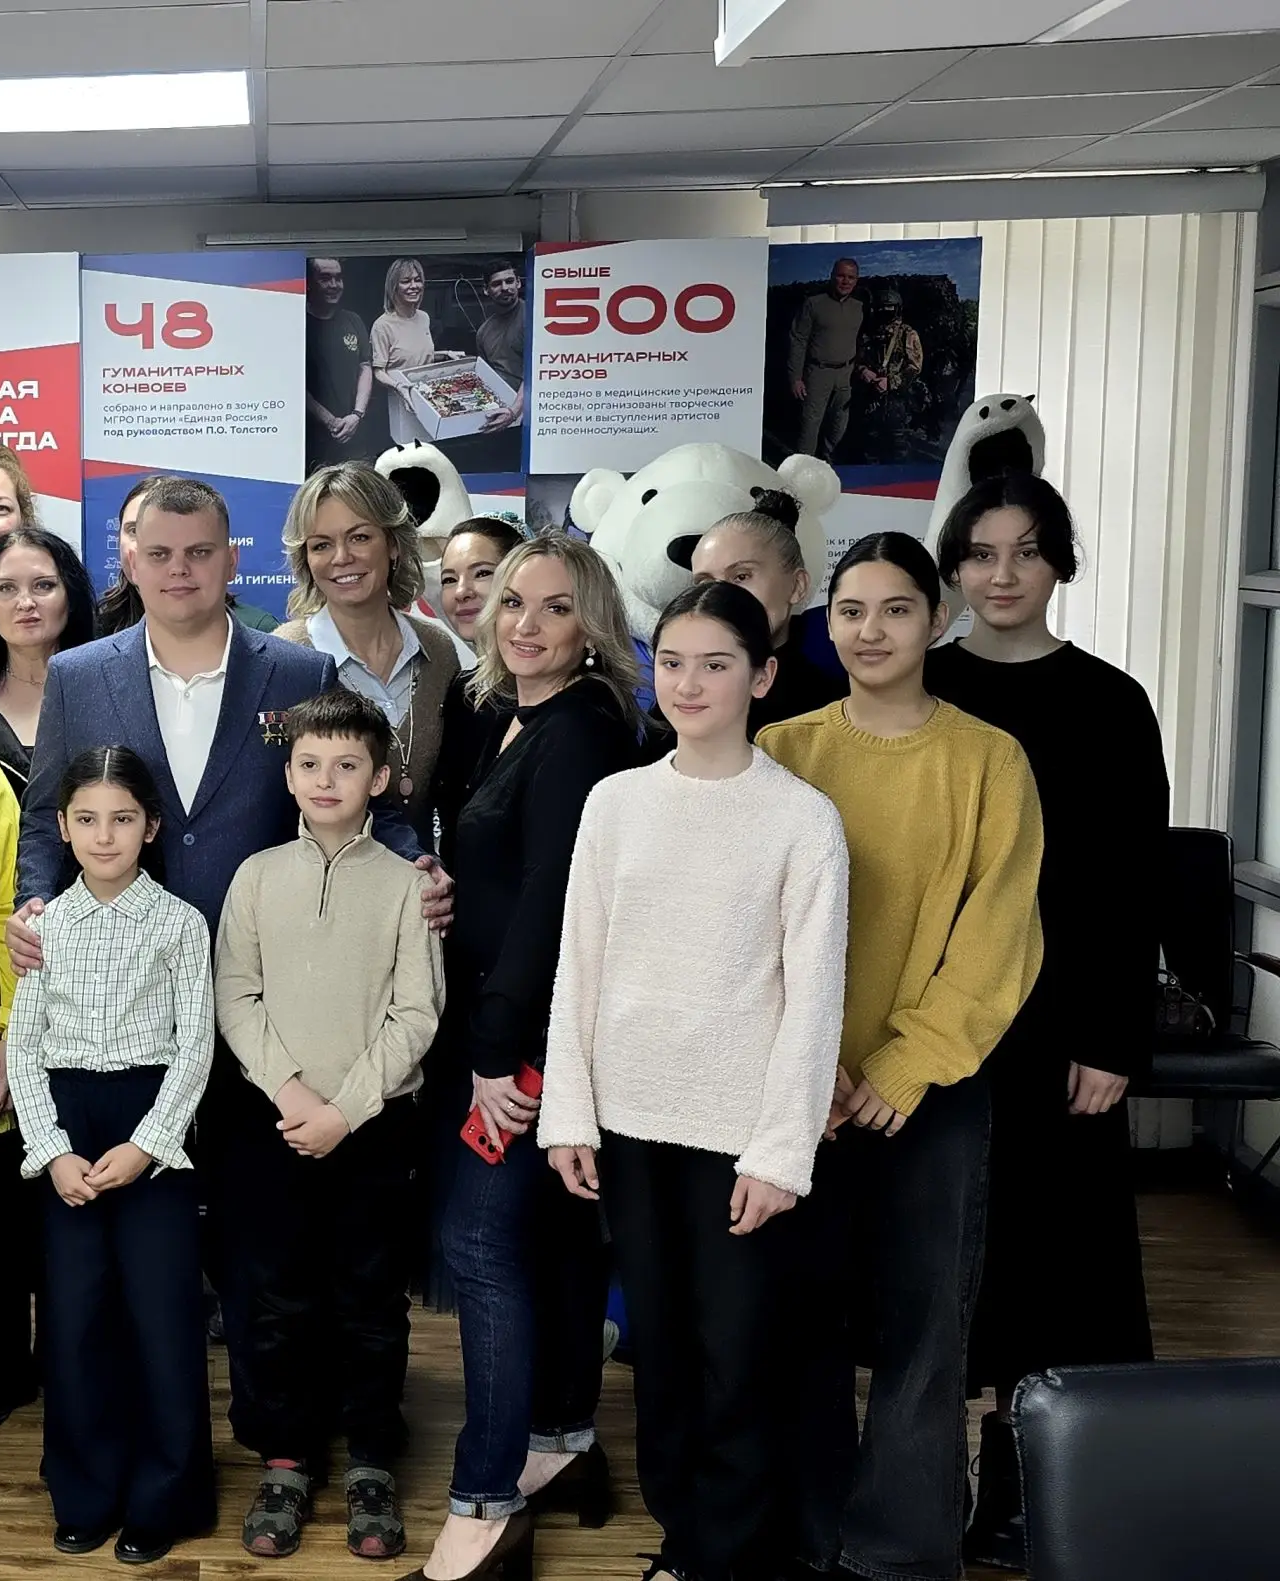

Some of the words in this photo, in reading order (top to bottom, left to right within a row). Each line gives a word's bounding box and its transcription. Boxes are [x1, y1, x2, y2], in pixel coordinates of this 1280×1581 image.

[541, 266, 611, 279] СВЫШЕ
[544, 283, 736, 336] 500
[105, 301, 214, 350] 48
[539, 350, 689, 365] ГУМАНИТАРНЫХ
[102, 364, 245, 379] ГУМАНИТАРНЫХ
[539, 368, 608, 381] ГРУЗОВ
[102, 382, 187, 394] КОНВОЕВ
[538, 390, 593, 400] передано
[595, 390, 602, 398] в
[604, 388, 681, 399] медицинские
[682, 387, 753, 398] учреждения
[102, 403, 148, 414] собрано
[149, 404, 157, 412] и
[159, 403, 224, 413] направлено
[226, 402, 233, 410] в
[235, 402, 260, 412] зону
[261, 400, 286, 410] СВО
[537, 402, 585, 411] Москвы,
[586, 401, 667, 412] организованы
[669, 400, 734, 410] творческие
[103, 415, 135, 425] МГРО
[136, 415, 176, 426] Партии
[178, 414, 223, 424] «Единая
[225, 412, 268, 422] Россия»
[536, 415, 583, 425] встречи
[595, 413, 668, 424] выступления
[670, 412, 721, 423] артистов
[103, 429, 124, 438] под
[126, 427, 203, 438] руководством
[206, 425, 228, 435] П.О.
[229, 425, 279, 435] Толстого
[537, 428, 558, 437] для
[560, 426, 659, 436] военнослужащих.
[228, 536, 254, 547] НИЯ
